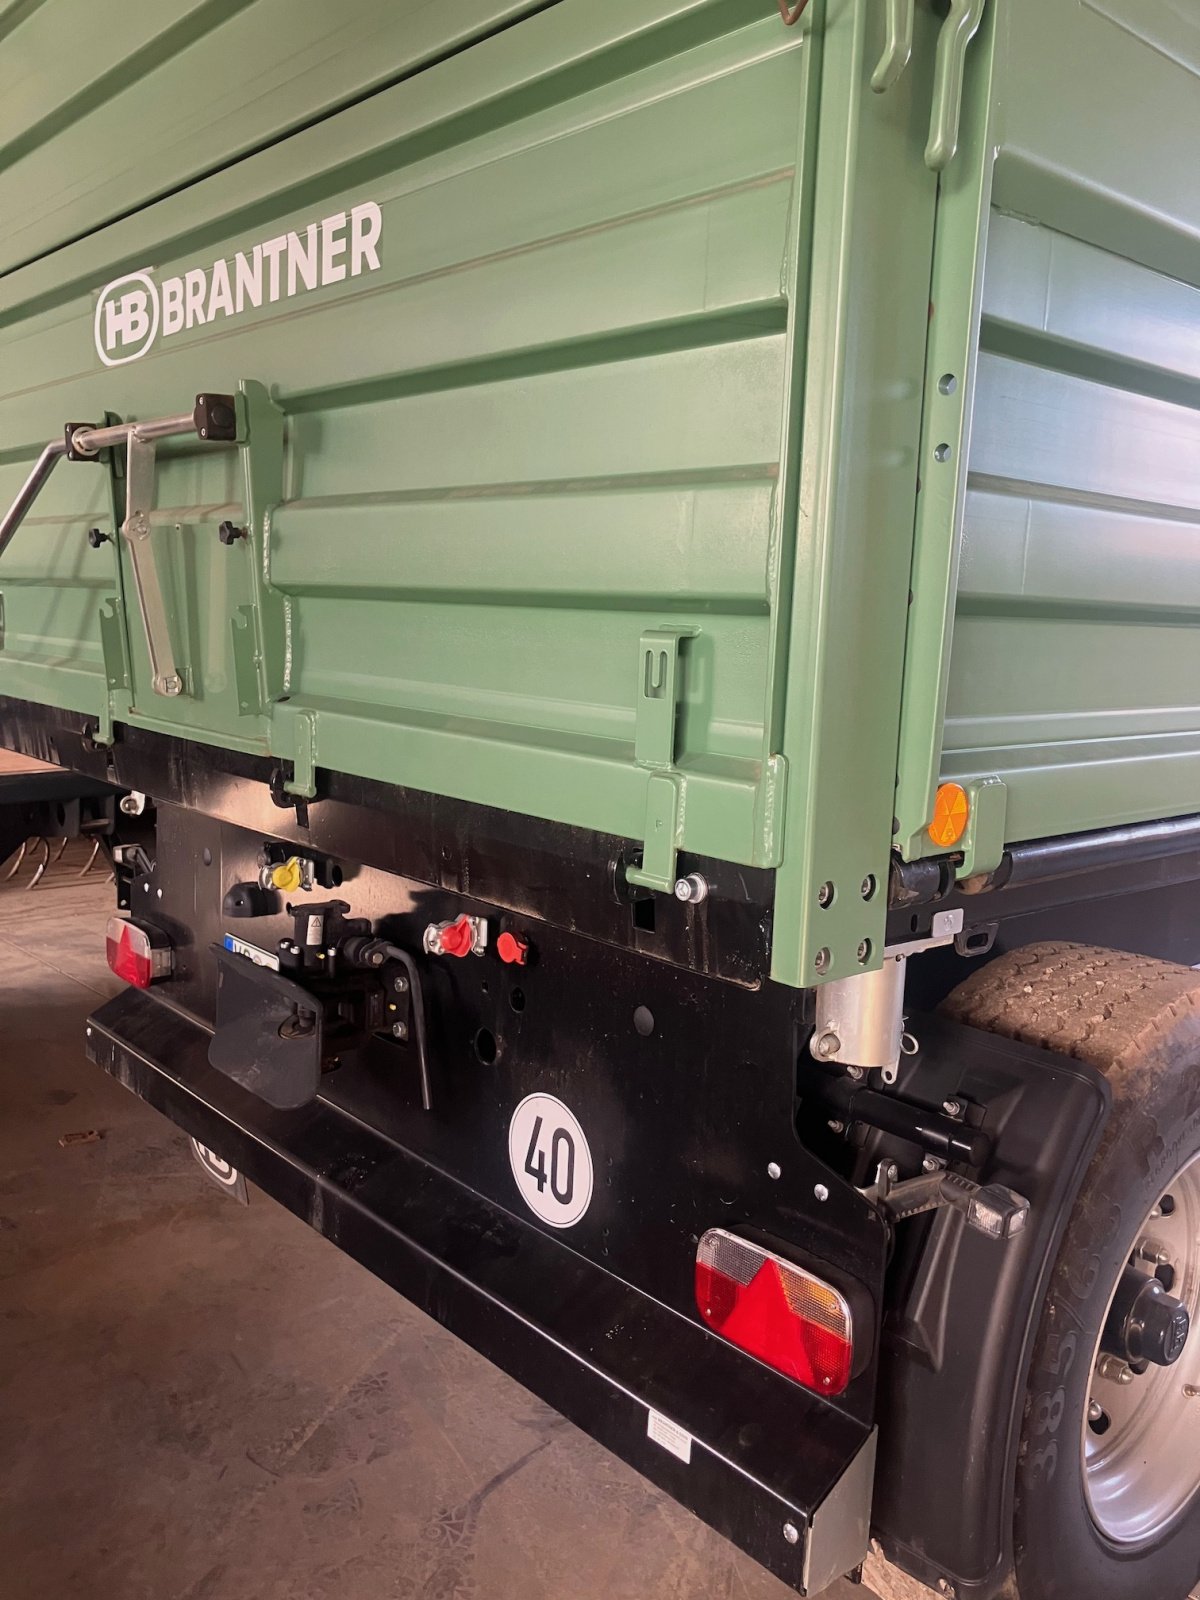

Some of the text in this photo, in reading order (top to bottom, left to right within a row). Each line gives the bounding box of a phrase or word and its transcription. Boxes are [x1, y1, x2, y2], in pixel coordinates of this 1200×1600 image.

[105, 201, 382, 350] HB BRANTNER
[524, 1115, 575, 1205] 40
